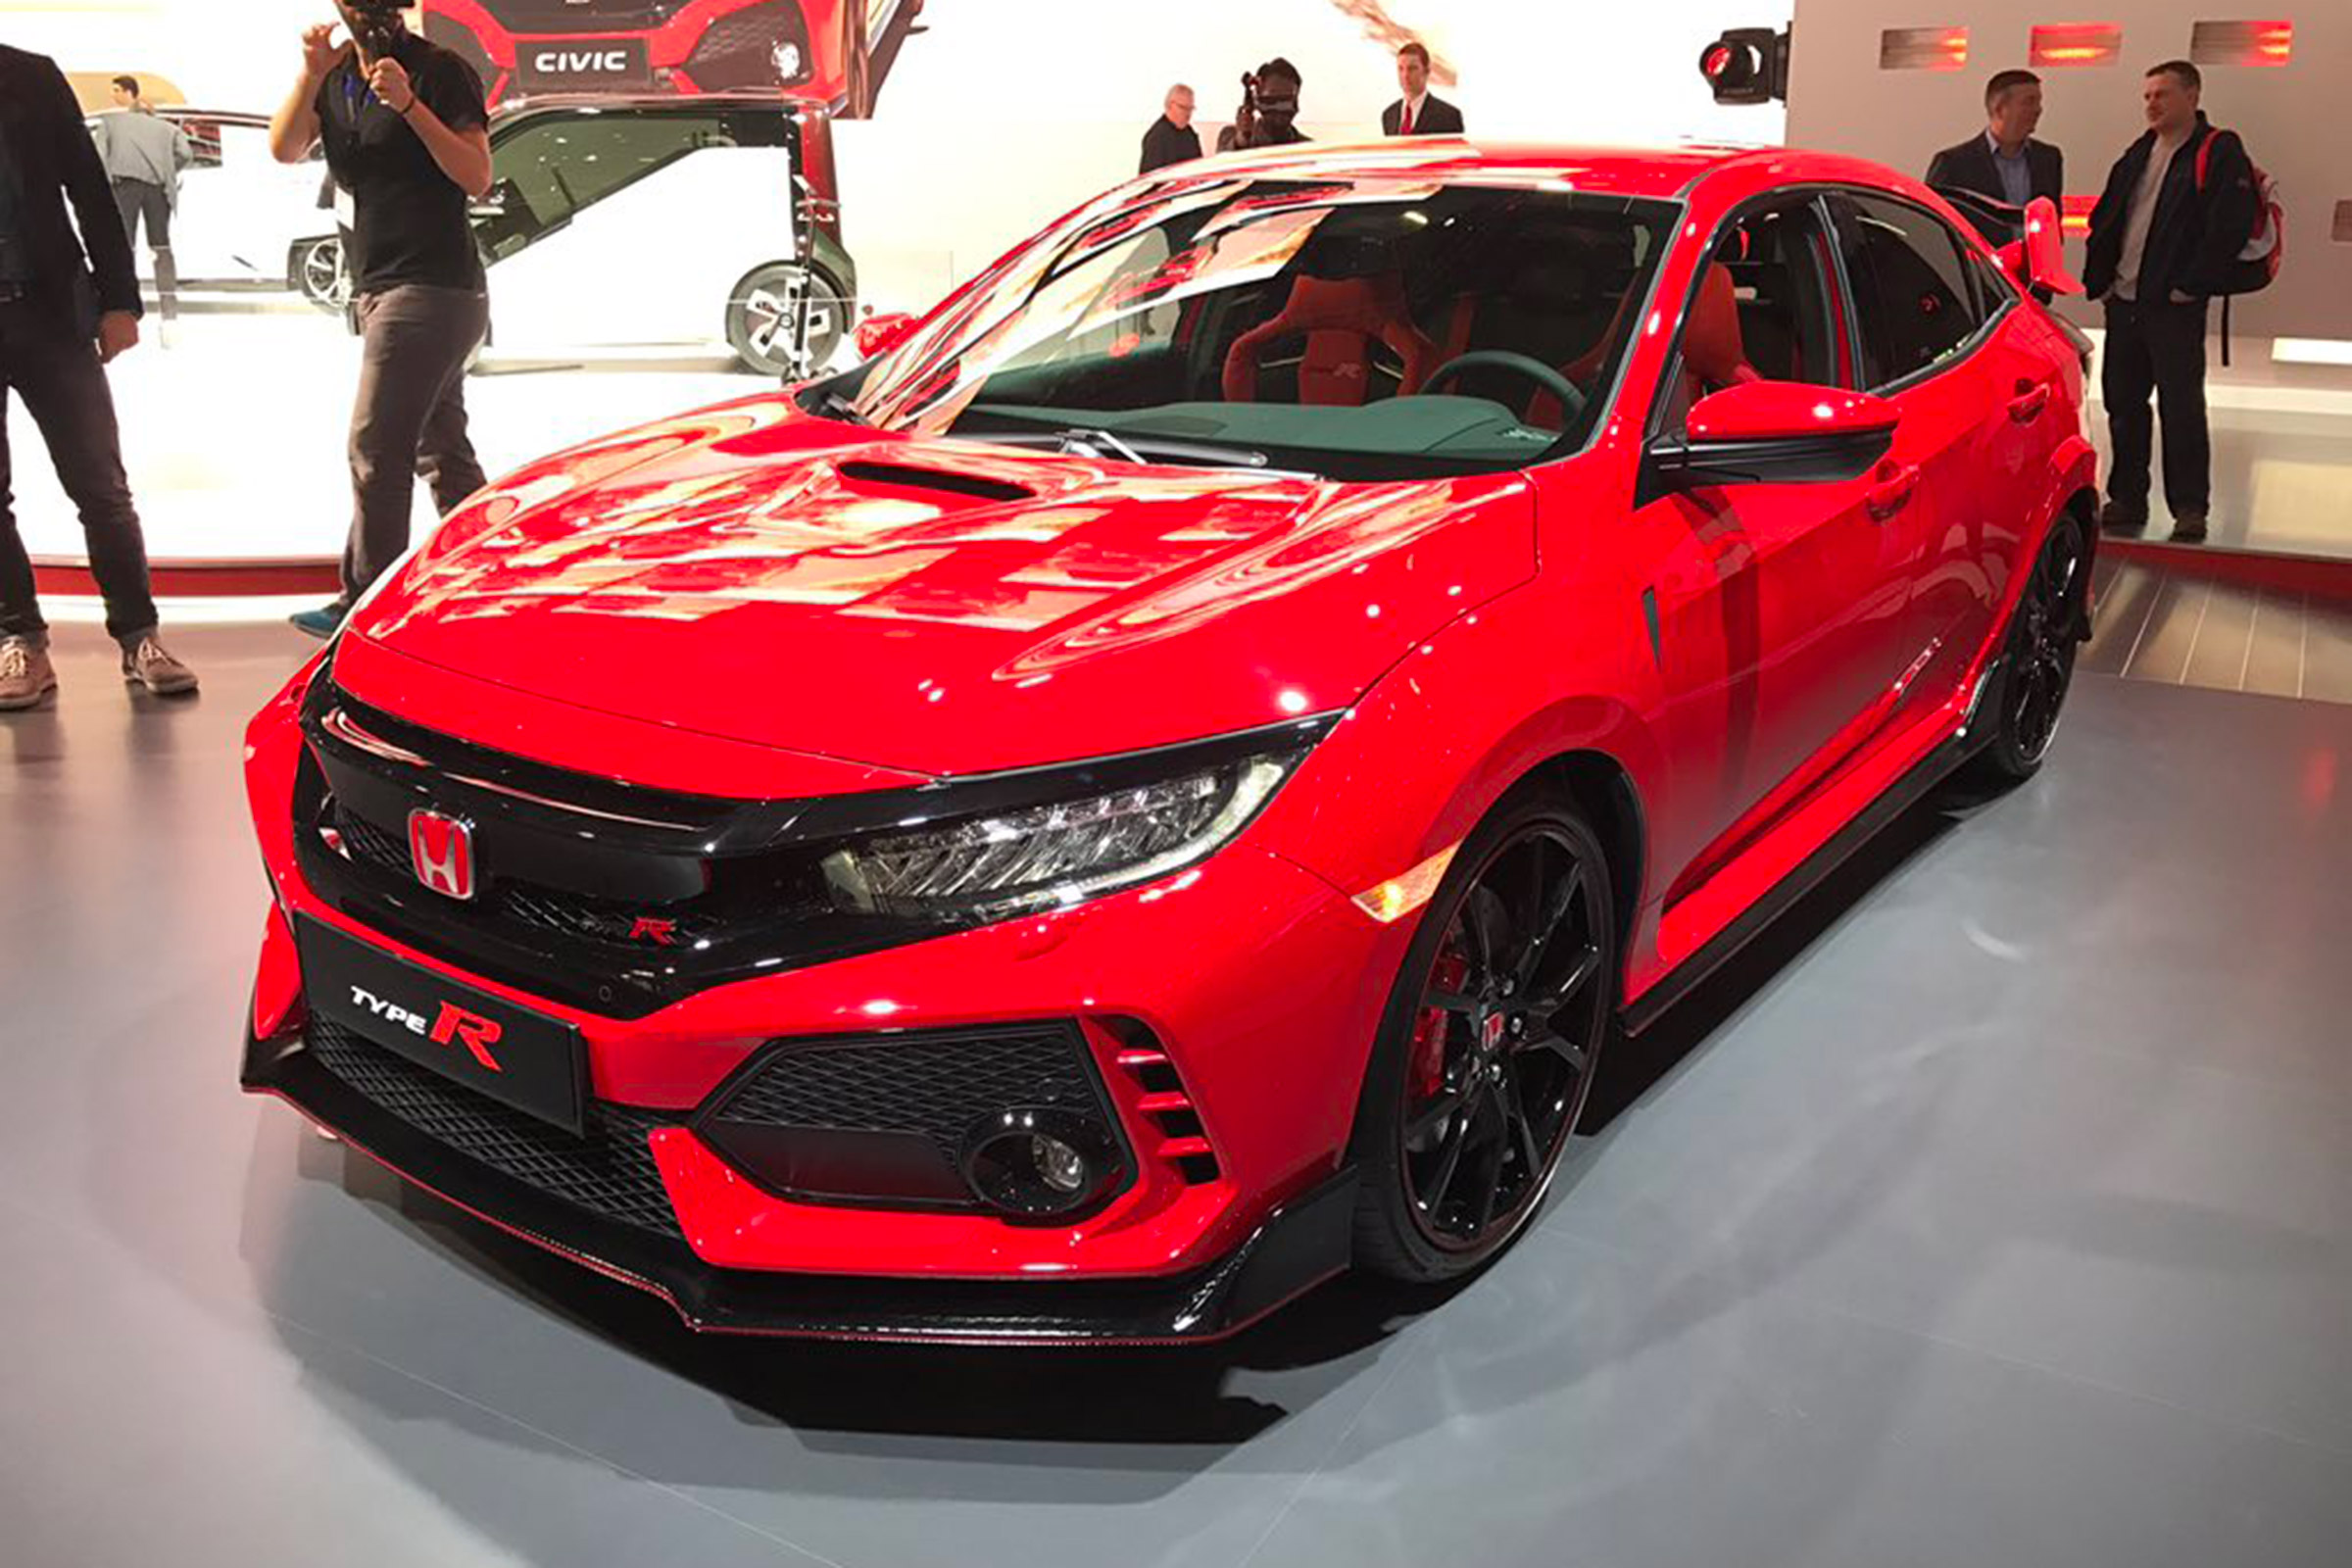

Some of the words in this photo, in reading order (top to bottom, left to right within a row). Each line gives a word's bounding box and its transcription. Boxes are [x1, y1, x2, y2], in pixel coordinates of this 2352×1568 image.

[535, 51, 626, 72] CIVIC
[629, 916, 676, 946] R
[350, 985, 426, 1035] TYPE
[429, 1000, 502, 1072] R
